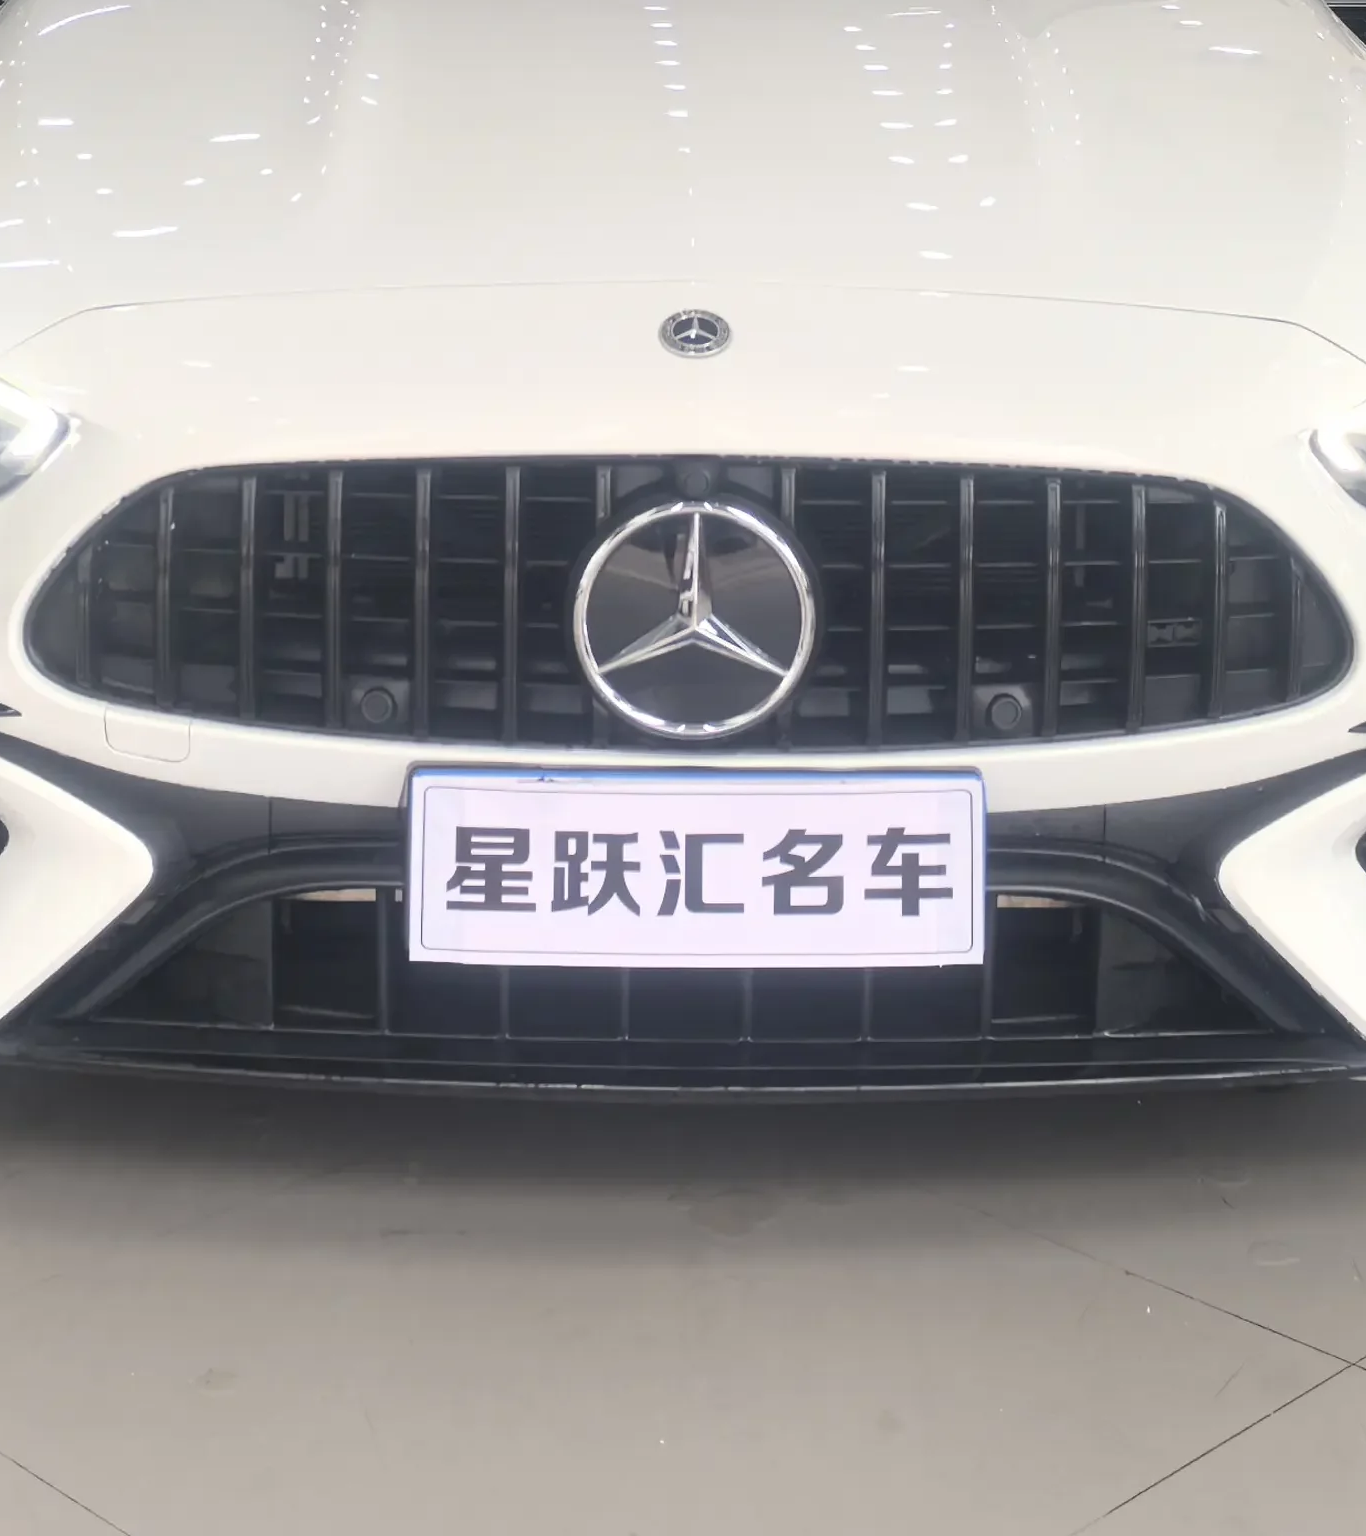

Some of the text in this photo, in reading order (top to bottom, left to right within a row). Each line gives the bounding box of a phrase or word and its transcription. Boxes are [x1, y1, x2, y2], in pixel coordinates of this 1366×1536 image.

[445, 824, 954, 917] 星跃汇名车
